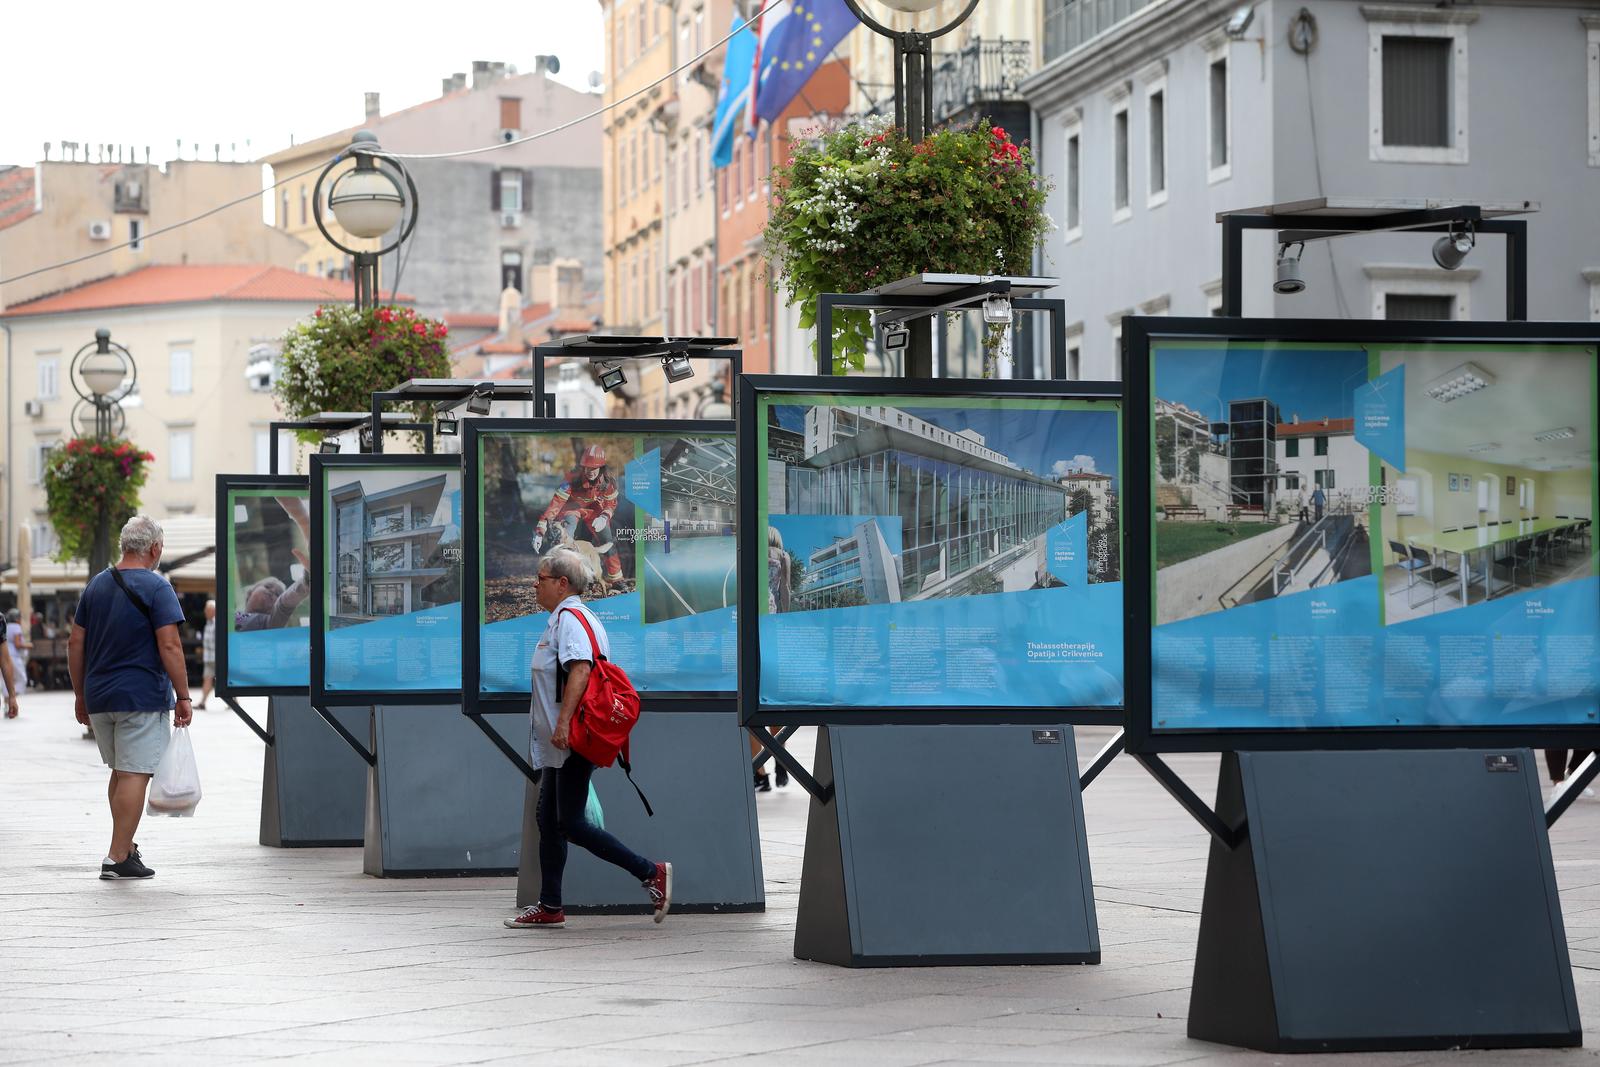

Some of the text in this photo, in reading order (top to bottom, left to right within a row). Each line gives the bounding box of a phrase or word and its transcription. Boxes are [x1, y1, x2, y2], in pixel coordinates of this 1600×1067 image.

[616, 525, 657, 537] primorsko
[630, 532, 667, 543] goranska
[1027, 642, 1095, 651] Thalassotherapije
[1027, 650, 1056, 659] Opatija
